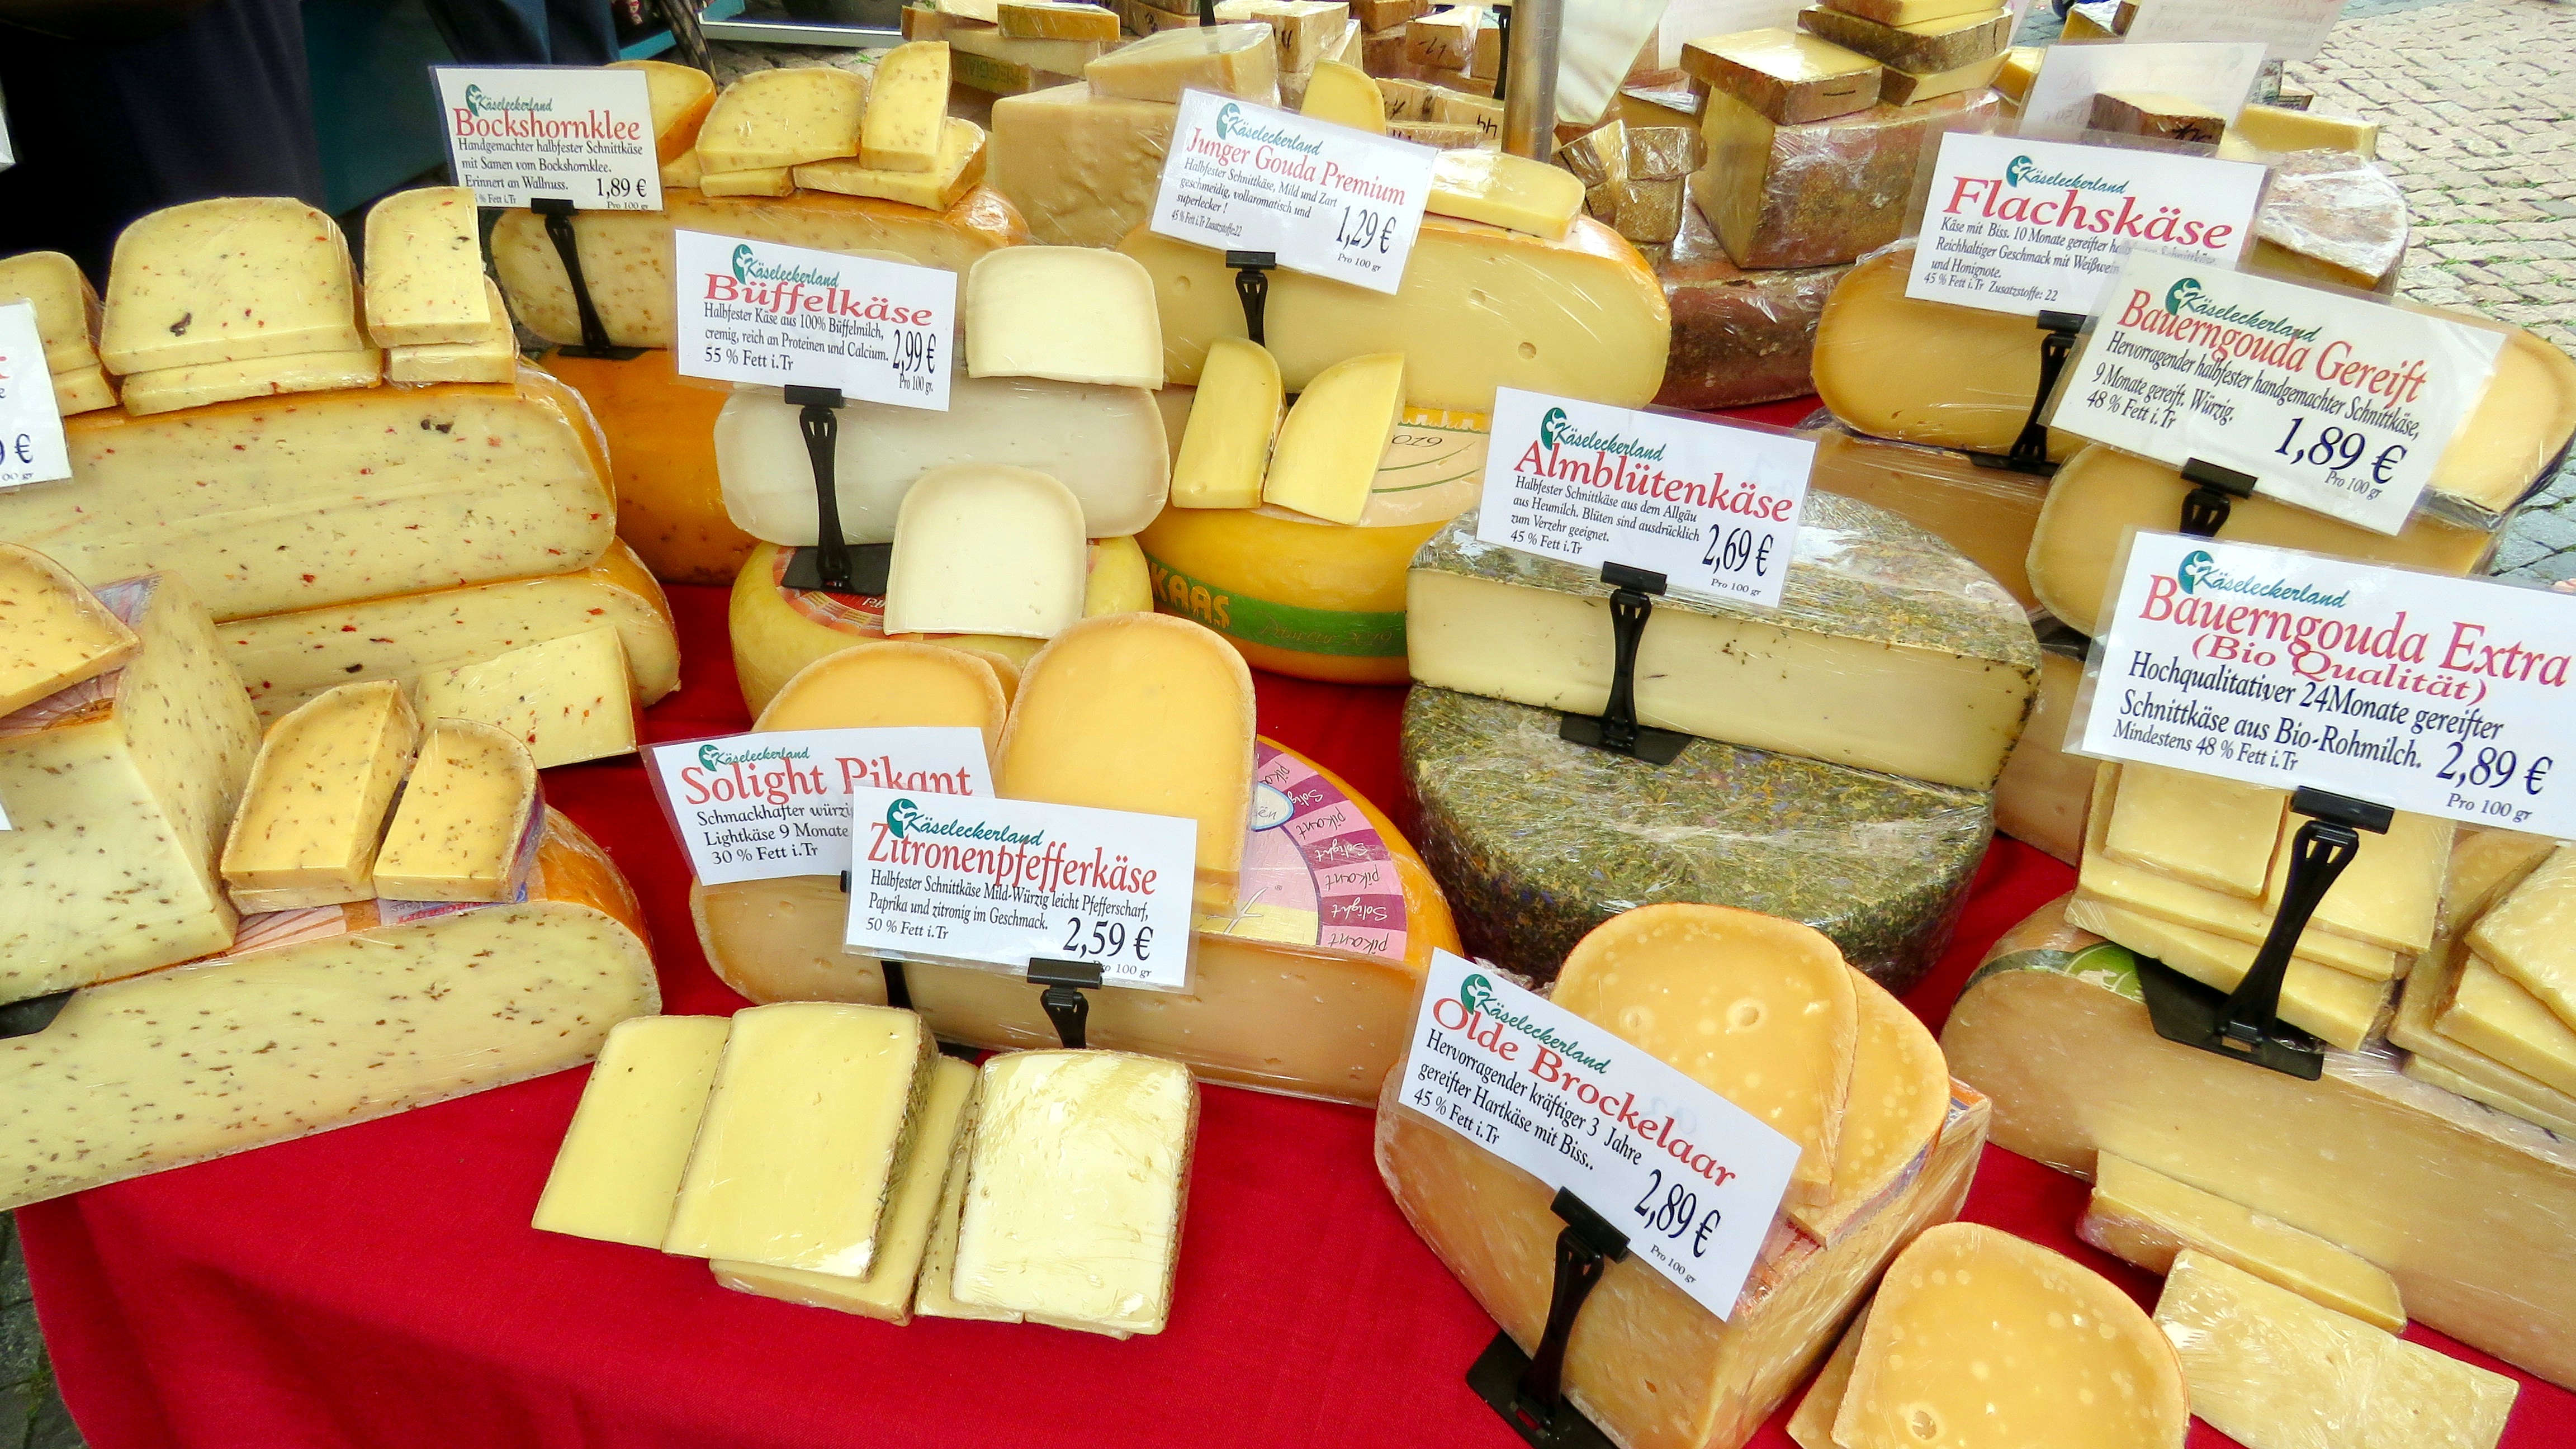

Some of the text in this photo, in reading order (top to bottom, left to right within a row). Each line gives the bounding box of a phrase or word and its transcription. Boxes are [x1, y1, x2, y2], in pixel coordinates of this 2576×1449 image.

[454, 108, 641, 140] Bockshornklee
[477, 96, 552, 112] Käseleckerland
[458, 139, 642, 155] Handgemachter halbfester Schnittkäse
[1228, 118, 1323, 155] Käseleckerland
[462, 158, 611, 173] mit Samen vom Bockshornklee.
[597, 178, 647, 197] 1,89 €
[1184, 158, 1337, 207] Halbfester Schnittkäse, Mild und Zart
[1187, 127, 1405, 206] Junger Gouda Premium
[2019, 167, 2129, 194] Käseleckerland
[1179, 178, 1311, 217] geschmeidig, vollaromatisch und
[1943, 177, 2232, 248] Flachskäse
[1336, 206, 1396, 253] 1,29 €
[1940, 217, 1963, 233] Käse
[1967, 221, 1982, 234] mit
[1988, 224, 2010, 238] Biss.
[2013, 228, 2025, 240] 10
[2028, 231, 2066, 247] Monate
[2067, 233, 2109, 253] gereifter
[745, 257, 840, 287] Käseleckerland
[1935, 239, 1996, 259] Reichhaltiger
[1999, 246, 2051, 264] Geschmack
[2054, 254, 2071, 267] mit
[704, 302, 884, 340] Halbfester Käse aus 100% Büffelmilch,
[705, 273, 933, 325] Büffelkäse
[2181, 291, 2323, 342] Käseleckerland
[705, 329, 888, 361] cremig, reich an Proteinen und Calcium.
[892, 329, 936, 374] 2,99 €
[2117, 289, 2428, 406] Bauerngouda Gereift
[2095, 367, 2233, 424] 9 Monate gereift. Würzig.
[2106, 331, 2420, 440] Hervorragender halbfester handgemachter Schnittkäse,
[1554, 424, 1666, 462] Käseleckerland
[2275, 417, 2407, 483] 1,89 €
[1514, 440, 1793, 522] Almblütenkäse
[1516, 475, 1697, 522] Halbfester Schnittkäse aus dem Allgäu
[1511, 515, 1609, 542] zum Verzehr geeignet.
[1513, 497, 1699, 541] aus Heumilch. Blüten sind ausdrücklich
[1510, 531, 1583, 554] 45 % Fett i.Tr
[1702, 523, 1774, 576] 2,69 €
[1711, 577, 1728, 588] Pro
[1731, 583, 1748, 593] 100
[2195, 565, 2351, 608] Käseleckerland
[2139, 575, 2572, 687] Bauerngouda Extra
[2191, 634, 2488, 704] (Bio Qualität)
[2128, 651, 2504, 742] Hochqualitativer 24Monate gereifter
[2113, 719, 2298, 771] Mindestens 48 % Fett i.Tr
[2120, 690, 2422, 769] Schnittkäse aus Bio-Rohmilch.
[713, 747, 810, 765] Käseleckerland
[2436, 741, 2553, 795] 2,89 €
[681, 756, 827, 806] Solight
[697, 805, 805, 826] Schmackhafter
[903, 811, 1044, 846] Käseleckerland
[1296, 807, 1346, 839] pikant
[2446, 794, 2532, 822] Pro 100 gr
[704, 823, 849, 847] Lightkäse 9 Monate
[1315, 839, 1368, 861] Solight
[868, 822, 1158, 895] Zitronenpfefferkäse
[1325, 864, 1379, 891] pikant
[869, 893, 1049, 930] Paprika und zitronig im Geschmack.
[870, 869, 1149, 921] Halbfester Schnittkäse Mild-Würzig leicht Pfefferscharf,
[1332, 897, 1388, 920] Solight
[1063, 917, 1153, 961] 2,59 €
[1328, 933, 1389, 955] pikant
[1478, 992, 1612, 1075] Käseleckerland
[1427, 1027, 1642, 1166] Hervorragender kräftiger 3 Jahre
[1433, 997, 1736, 1188] Olde Brockelaar
[1417, 1063, 1593, 1171] gereifter Hartkäse mit Biss..
[1634, 1168, 1721, 1258] 2,89 €
